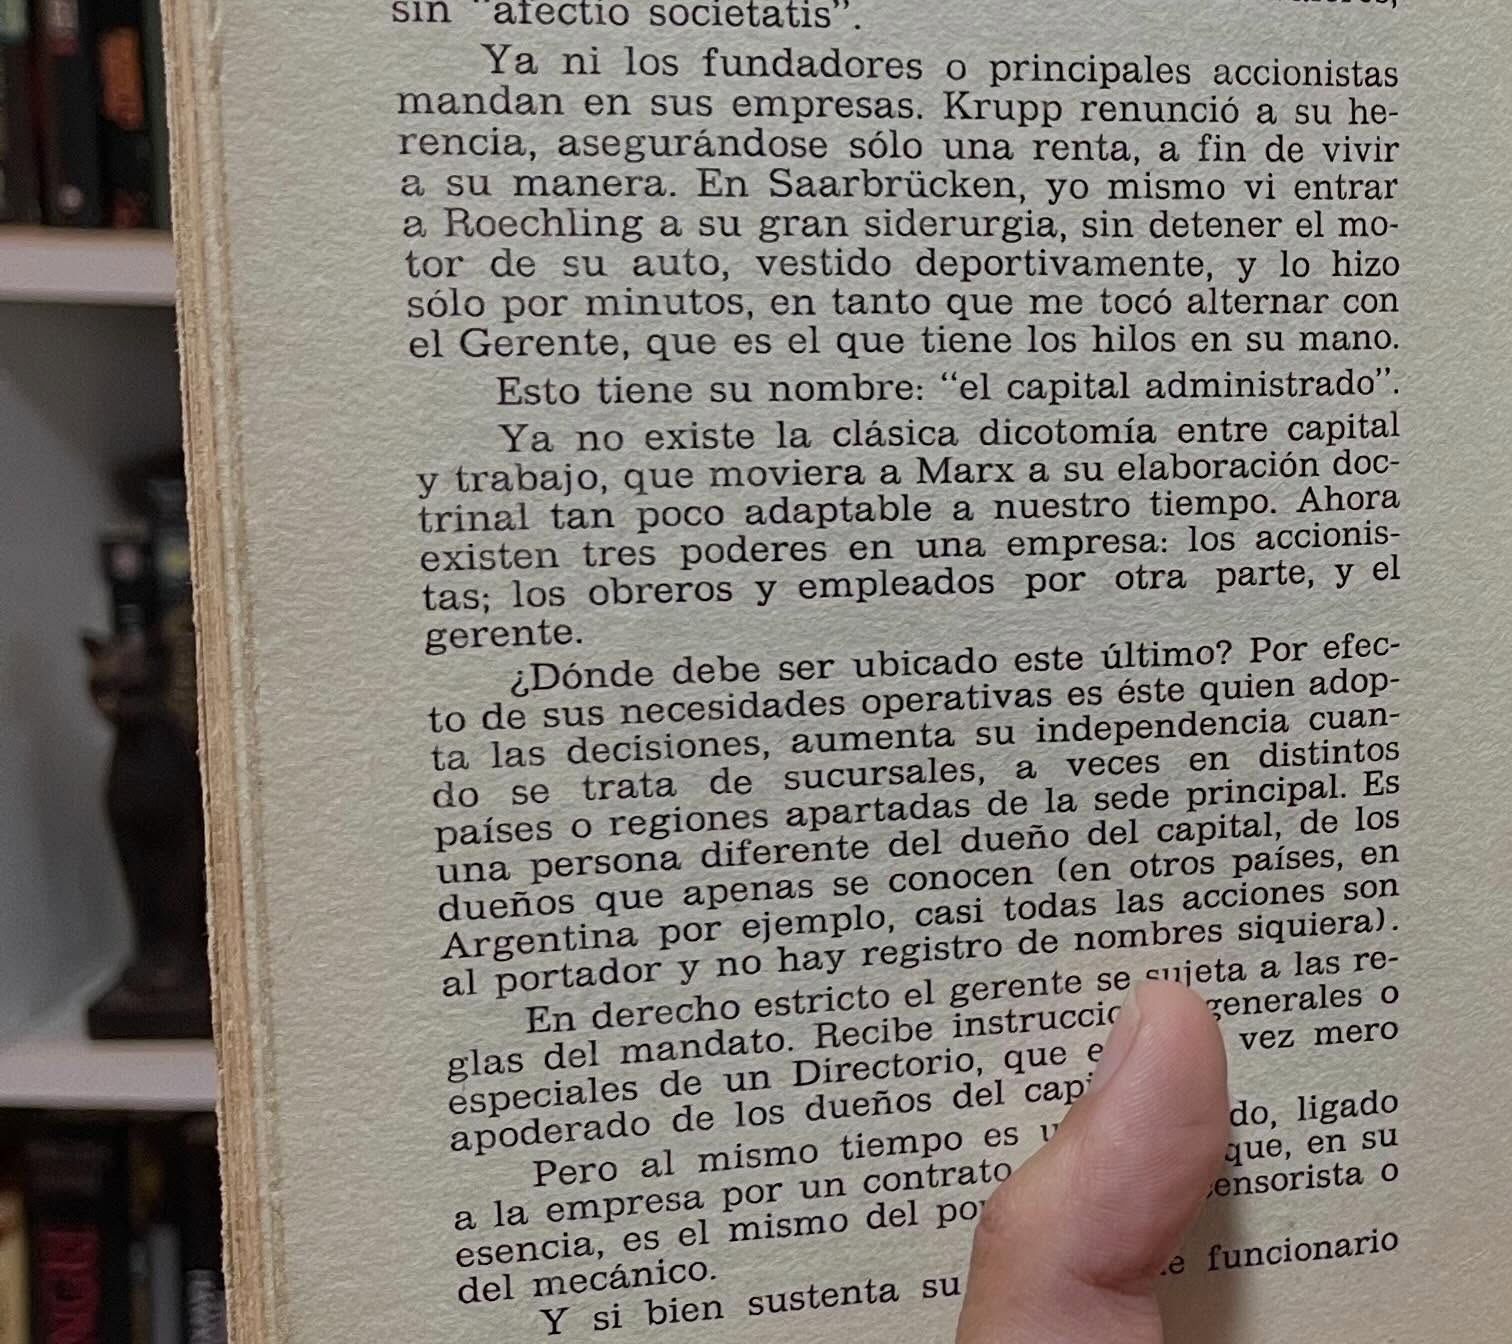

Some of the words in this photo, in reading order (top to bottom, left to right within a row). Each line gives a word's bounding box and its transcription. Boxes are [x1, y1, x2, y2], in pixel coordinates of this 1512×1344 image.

[404, 249, 465, 279] tor
[489, 247, 536, 278] de
[562, 255, 609, 278] su
[632, 247, 729, 283] auto,
[754, 246, 892, 278] vestido
[915, 246, 1213, 283] deportivamente,
[1235, 256, 1257, 284] y
[1279, 249, 1310, 278] lo
[1331, 249, 1400, 278] hizo
[495, 375, 580, 406] Esto
[596, 375, 693, 405] tiene
[709, 381, 753, 404] su
[767, 372, 923, 402] nombre:
[1006, 370, 1131, 407] capital
[417, 501, 531, 534] trinal
[549, 502, 616, 530] tan
[635, 504, 725, 535] poco
[745, 493, 932, 530] adaptable
[952, 500, 975, 522] a
[992, 491, 1131, 520] nuestro
[1148, 490, 1277, 521] tiempo.
[1295, 484, 1401, 514] Ahora
[424, 618, 583, 656] gerente.
[672, 654, 761, 685] debe
[778, 658, 836, 682] ser
[850, 646, 998, 679] ubicado
[1014, 645, 1084, 673] este
[1100, 639, 1233, 670] último?
[1249, 636, 1309, 664] Por
[1322, 632, 1401, 660] efec-
[433, 816, 553, 854] países
[570, 817, 593, 839] o
[608, 808, 769, 841] regiones
[785, 792, 971, 833] apartadas
[987, 789, 1028, 817] de
[1044, 787, 1079, 814] la
[1094, 782, 1170, 812] sede
[1185, 772, 1347, 814] principal.
[1362, 769, 1400, 797] Es
[439, 925, 639, 963] Argentina
[657, 920, 723, 951] por
[741, 903, 895, 945] ejemplo,
[914, 903, 985, 927] casi
[1003, 891, 1097, 922] todas
[1115, 888, 1165, 915] las
[1182, 883, 1325, 911] acciones
[1343, 878, 1401, 901] son
[538, 1306, 571, 1337] Y
[593, 1302, 623, 1332] si
[643, 1296, 725, 1326] bien
[748, 1278, 900, 1316] sustenta
[922, 1276, 961, 1299] su
[1207, 1227, 1399, 1272] funcionario
